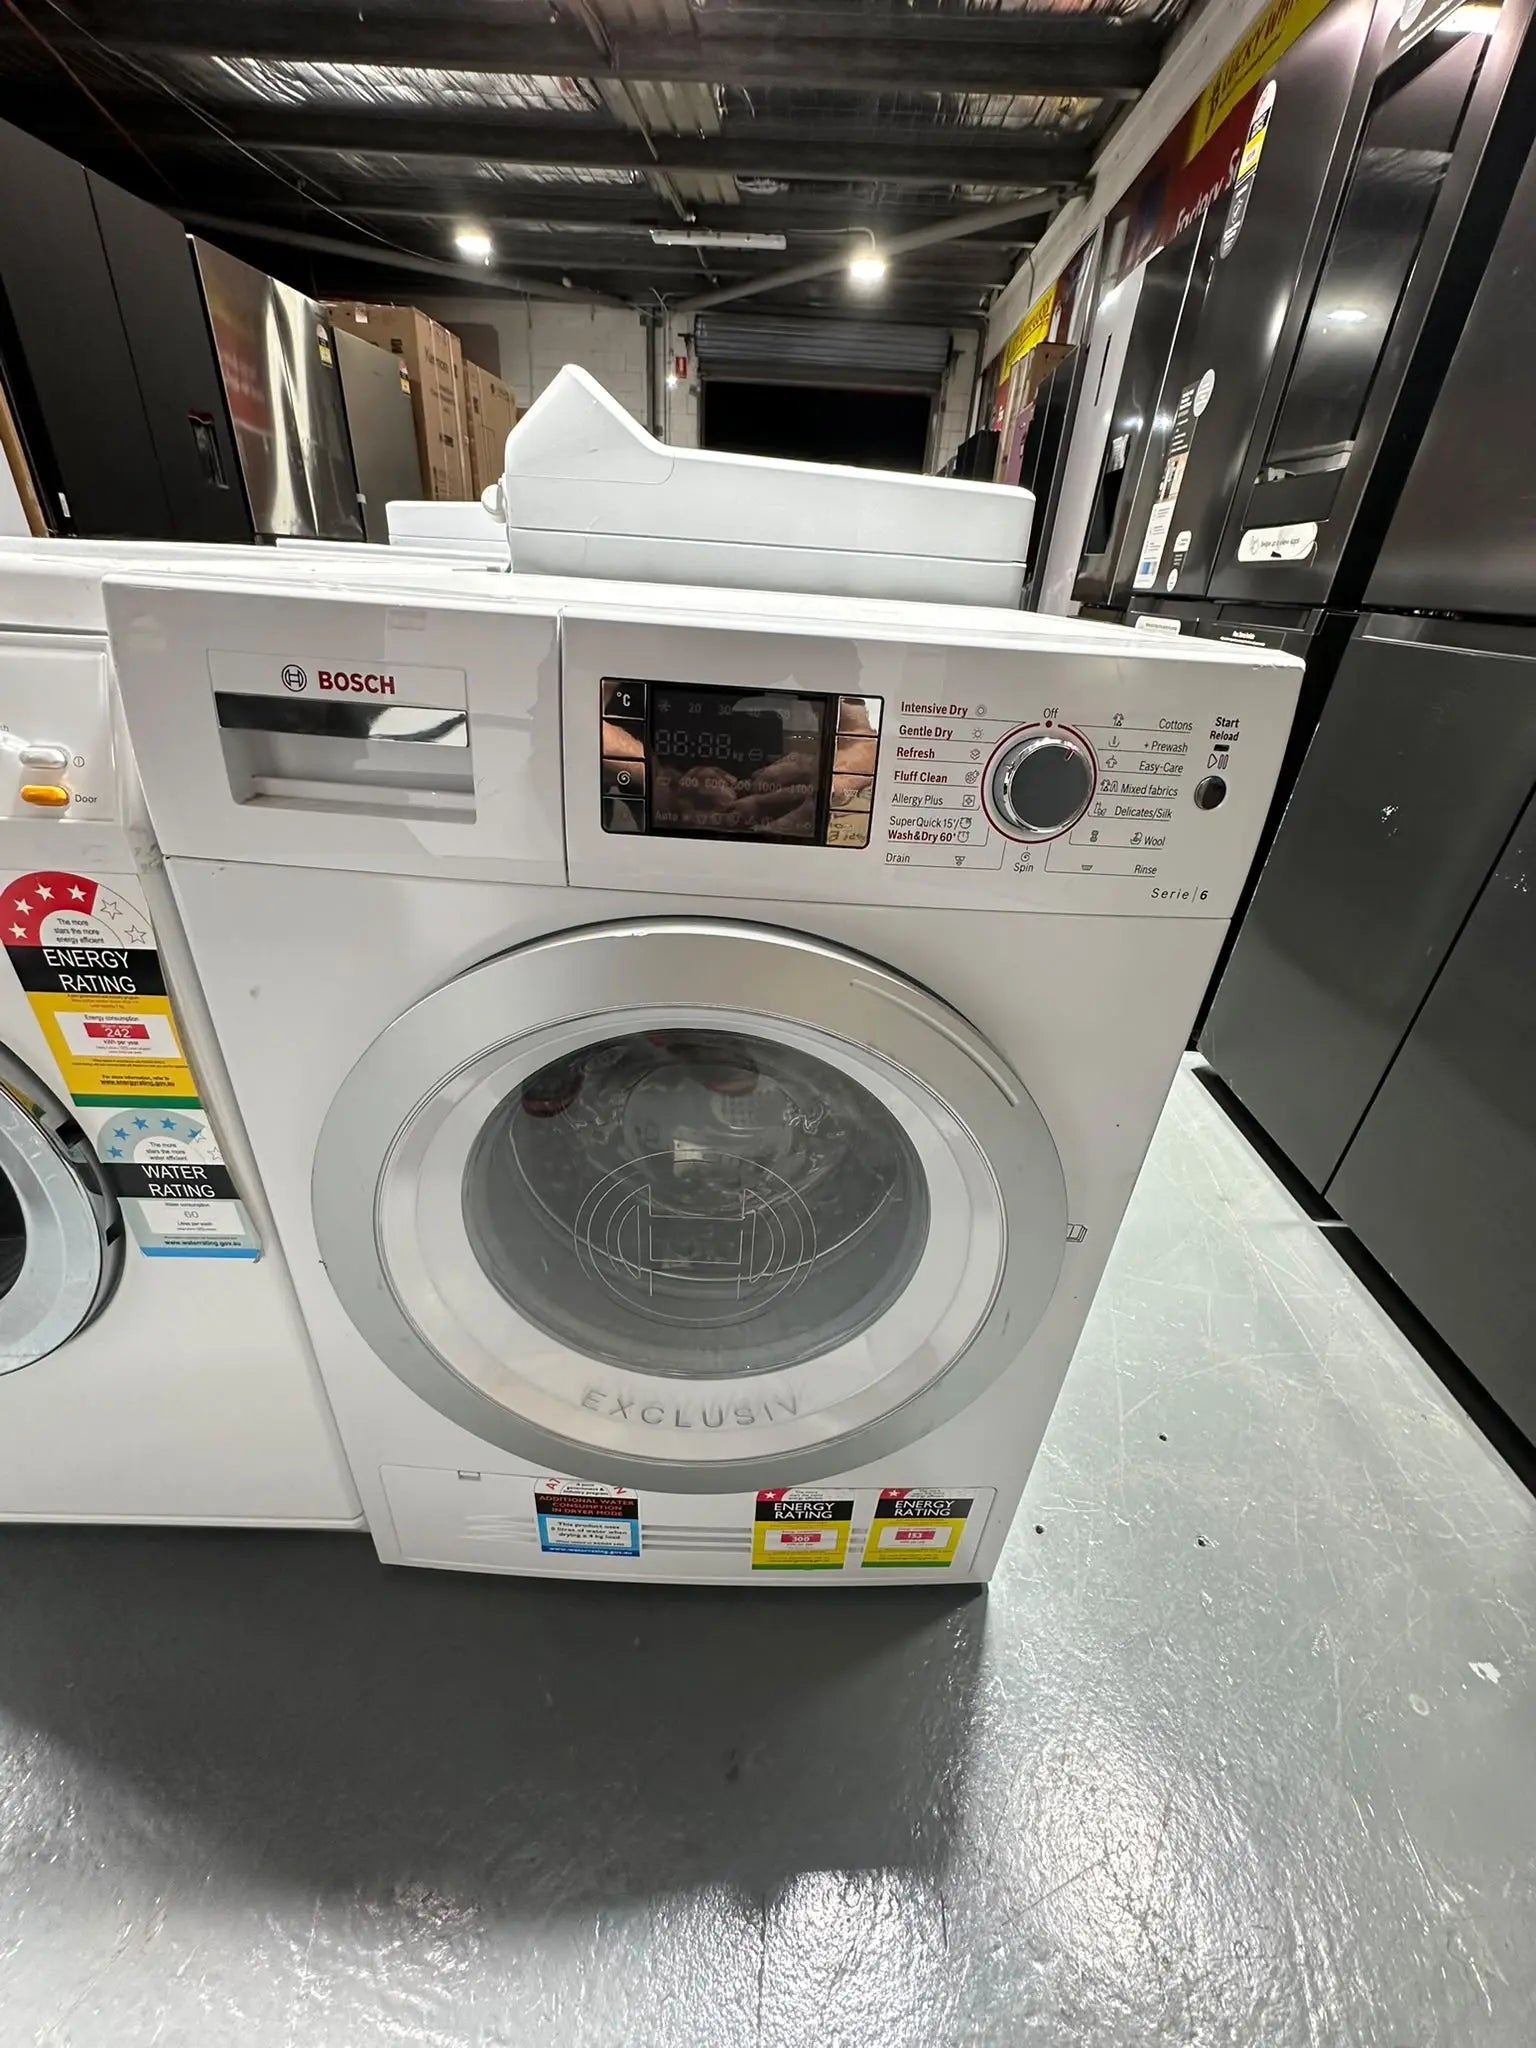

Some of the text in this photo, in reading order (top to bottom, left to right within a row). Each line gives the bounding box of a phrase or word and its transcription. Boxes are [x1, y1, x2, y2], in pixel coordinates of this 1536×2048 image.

[318, 670, 395, 695] BOSCH
[616, 691, 631, 707] °C
[901, 701, 968, 718] Intensive Dry
[1043, 707, 1059, 718] Off
[1158, 718, 1193, 731] Cottons
[1215, 716, 1240, 728] Start
[899, 724, 953, 740] Gentle Dry
[1209, 730, 1240, 742] Reload
[896, 746, 935, 759] Refresh
[1151, 740, 1188, 753] Prewash
[1139, 760, 1184, 775] Easy-Care
[894, 770, 948, 783] Fluff Clean
[1120, 783, 1178, 797] Mixed fabrics
[74, 793, 98, 804] Door
[891, 793, 943, 807] Allergy Plus
[655, 810, 679, 822] Auto
[1114, 805, 1173, 819] Delicates/Silk
[888, 829, 939, 844] Wash&Dry
[1144, 836, 1166, 847] Wool
[885, 852, 911, 863] Drain
[1013, 862, 1034, 874] Spin
[1134, 864, 1158, 875] Rinse
[1150, 887, 1209, 901] Serie 6
[82, 928, 100, 936] more
[42, 948, 130, 969] ENERGY
[58, 973, 137, 993] RATING
[104, 1027, 132, 1038] 242
[141, 1164, 208, 1180] WATER
[148, 1183, 216, 1198] RATING
[580, 1388, 799, 1429] EXCLUSIV
[539, 1495, 635, 1506] ADDITIONAL WATER
[552, 1502, 623, 1511] CONSUMPTION
[774, 1502, 836, 1511] ENERGY
[895, 1500, 955, 1508] ENERGY
[563, 1508, 594, 1516] DRYER
[595, 1509, 624, 1517] MODE
[774, 1511, 833, 1519] RATING
[894, 1508, 951, 1517] RATING
